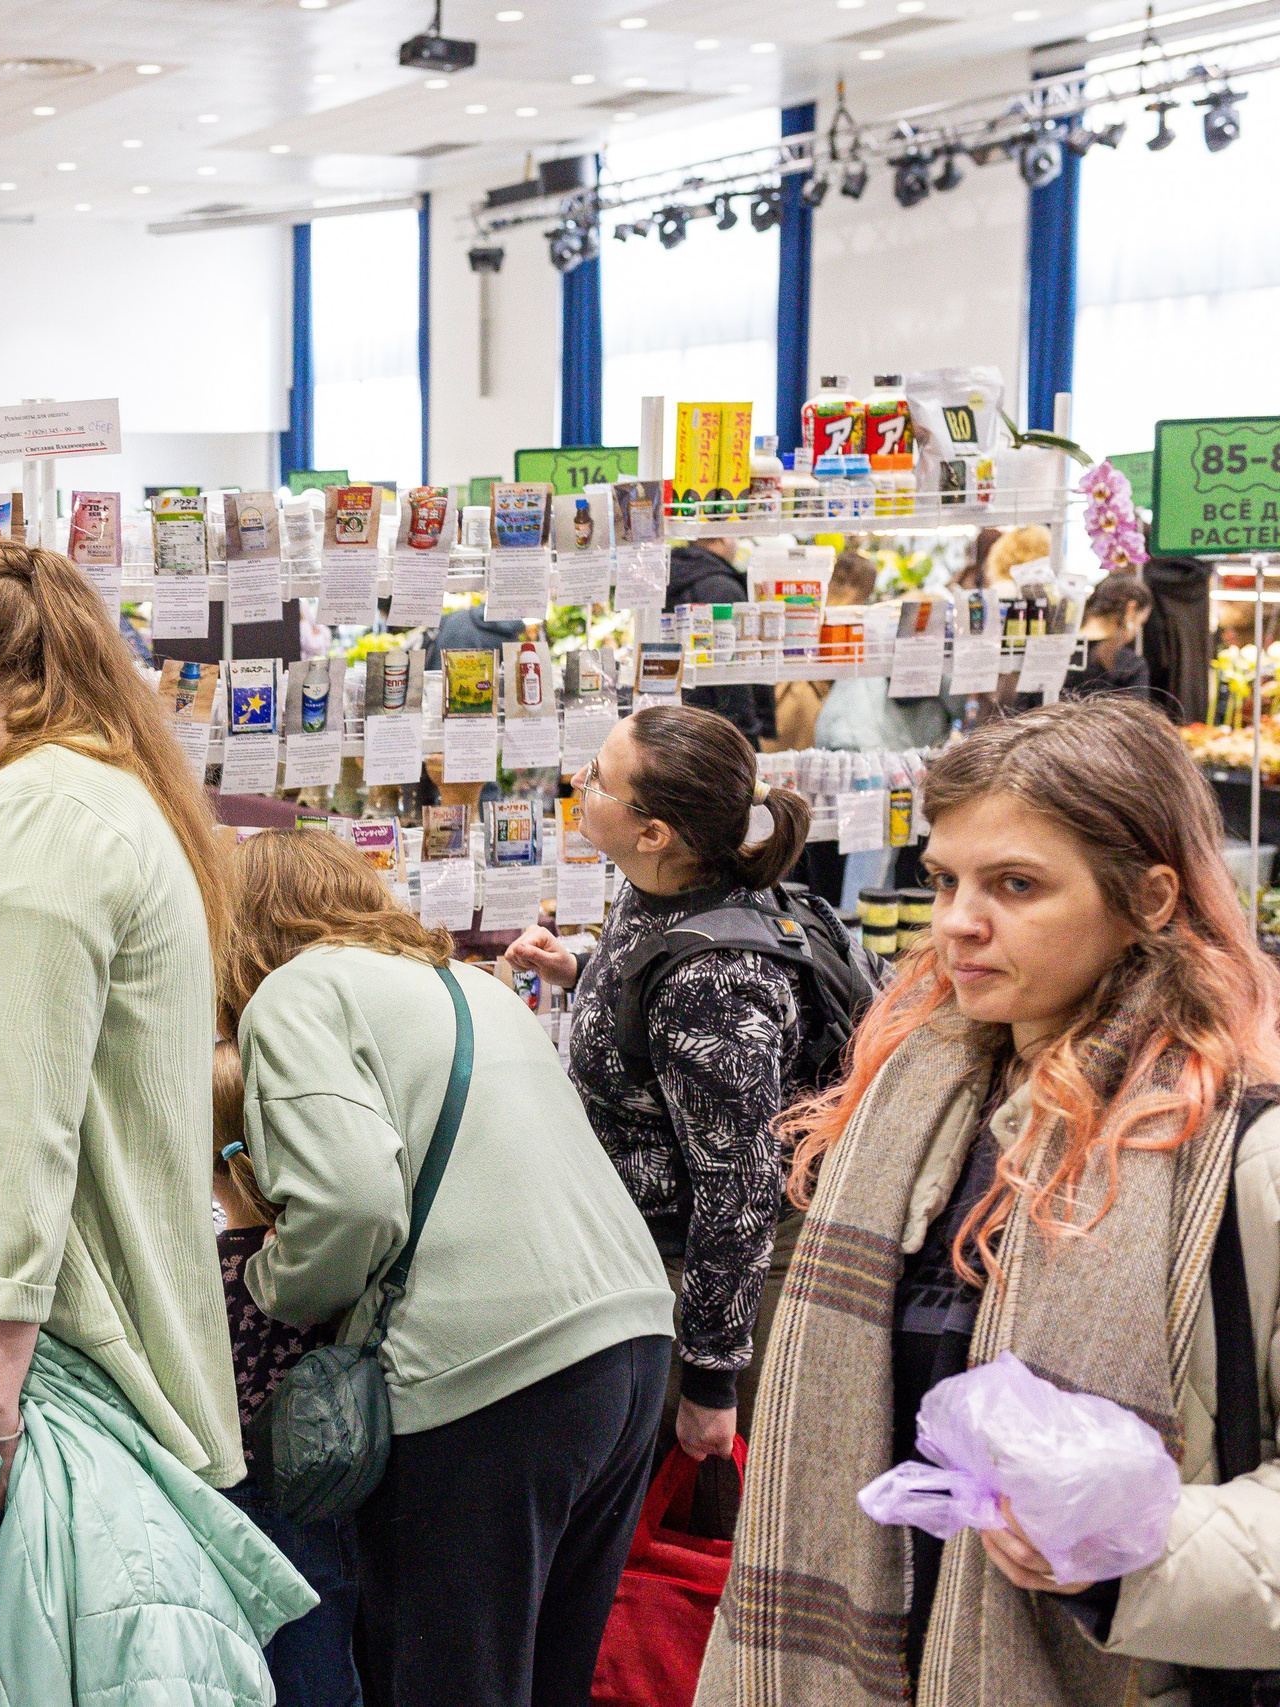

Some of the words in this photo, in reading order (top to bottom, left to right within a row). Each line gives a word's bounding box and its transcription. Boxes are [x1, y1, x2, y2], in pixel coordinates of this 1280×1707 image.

[25, 443, 55, 453] Светлана
[568, 467, 608, 488] 114
[1203, 499, 1251, 521] ВСЁ
